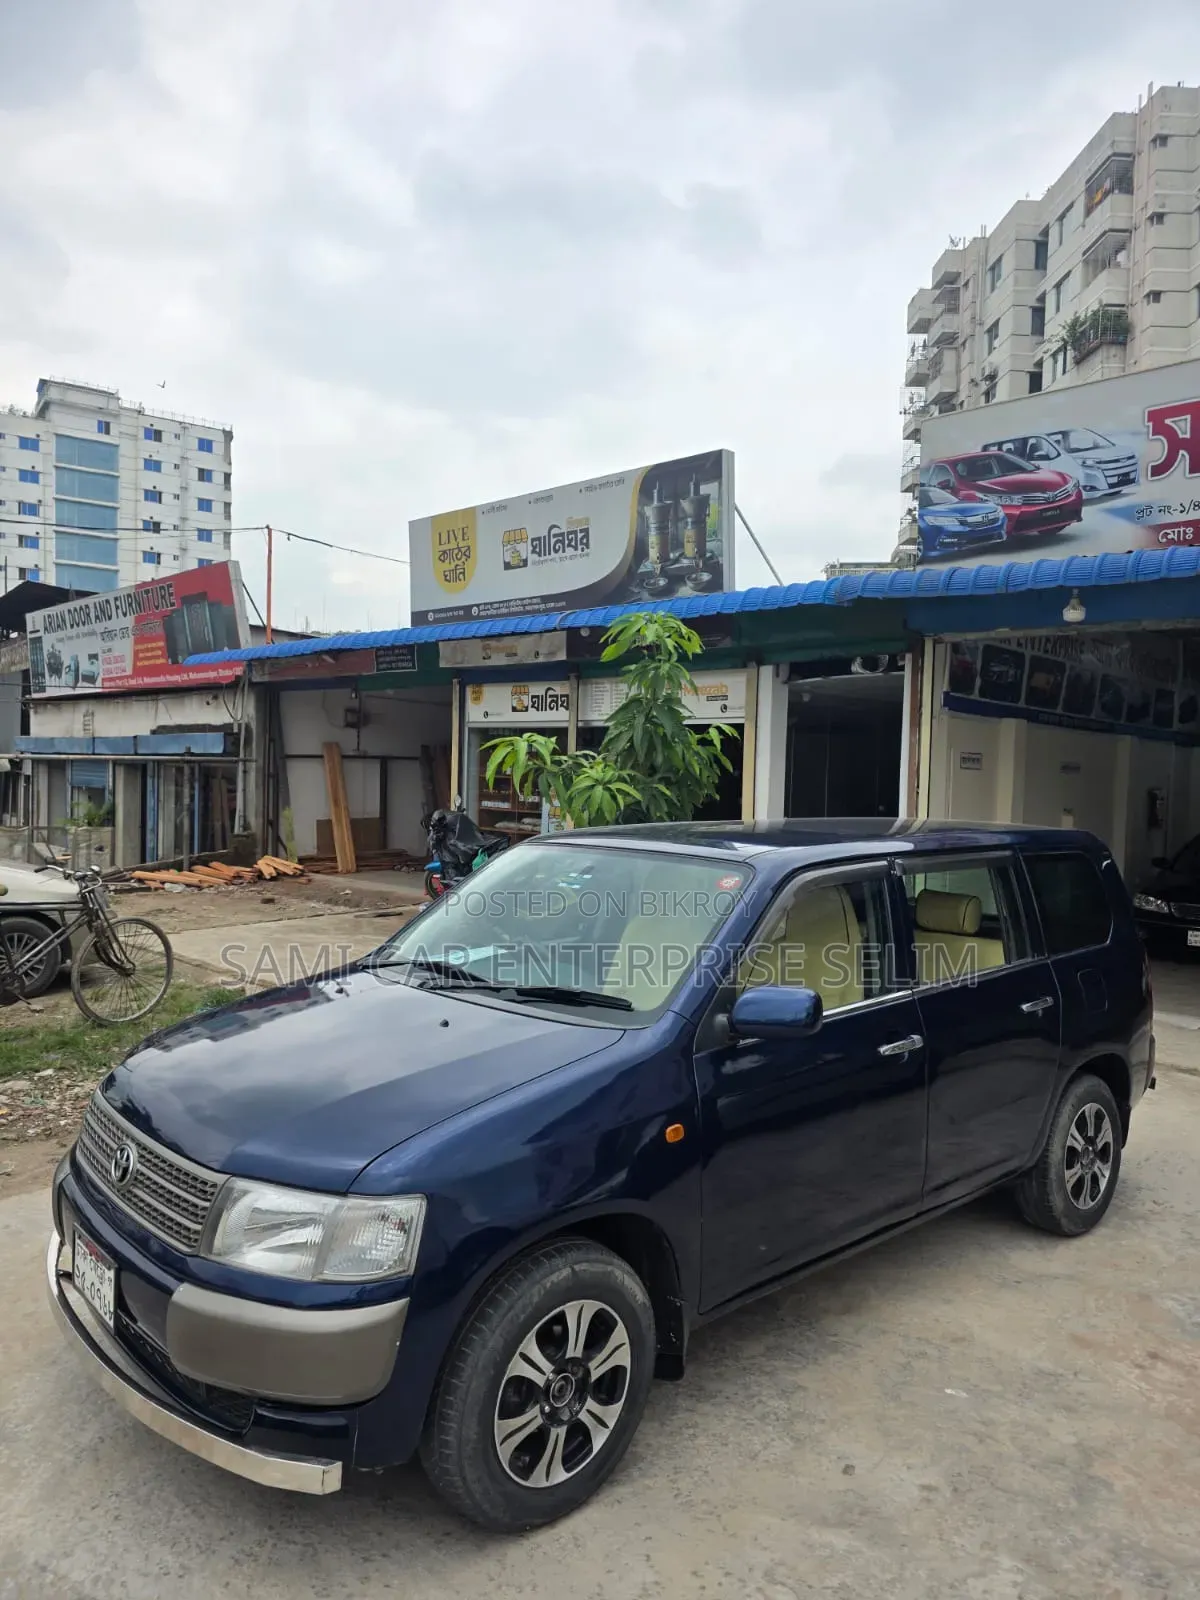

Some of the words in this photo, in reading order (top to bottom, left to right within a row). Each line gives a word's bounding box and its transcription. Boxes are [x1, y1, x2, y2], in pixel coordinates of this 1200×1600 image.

[438, 526, 470, 546] LIVE
[530, 524, 590, 558] ঘানিঘর
[438, 541, 471, 565] কাঠের
[443, 561, 466, 583] ঘানি
[43, 610, 67, 635] ARIAN
[67, 604, 94, 629] DOOR
[93, 599, 113, 624] AND
[114, 583, 176, 619] FURNITURE
[530, 687, 569, 712] ঘানিঘ
